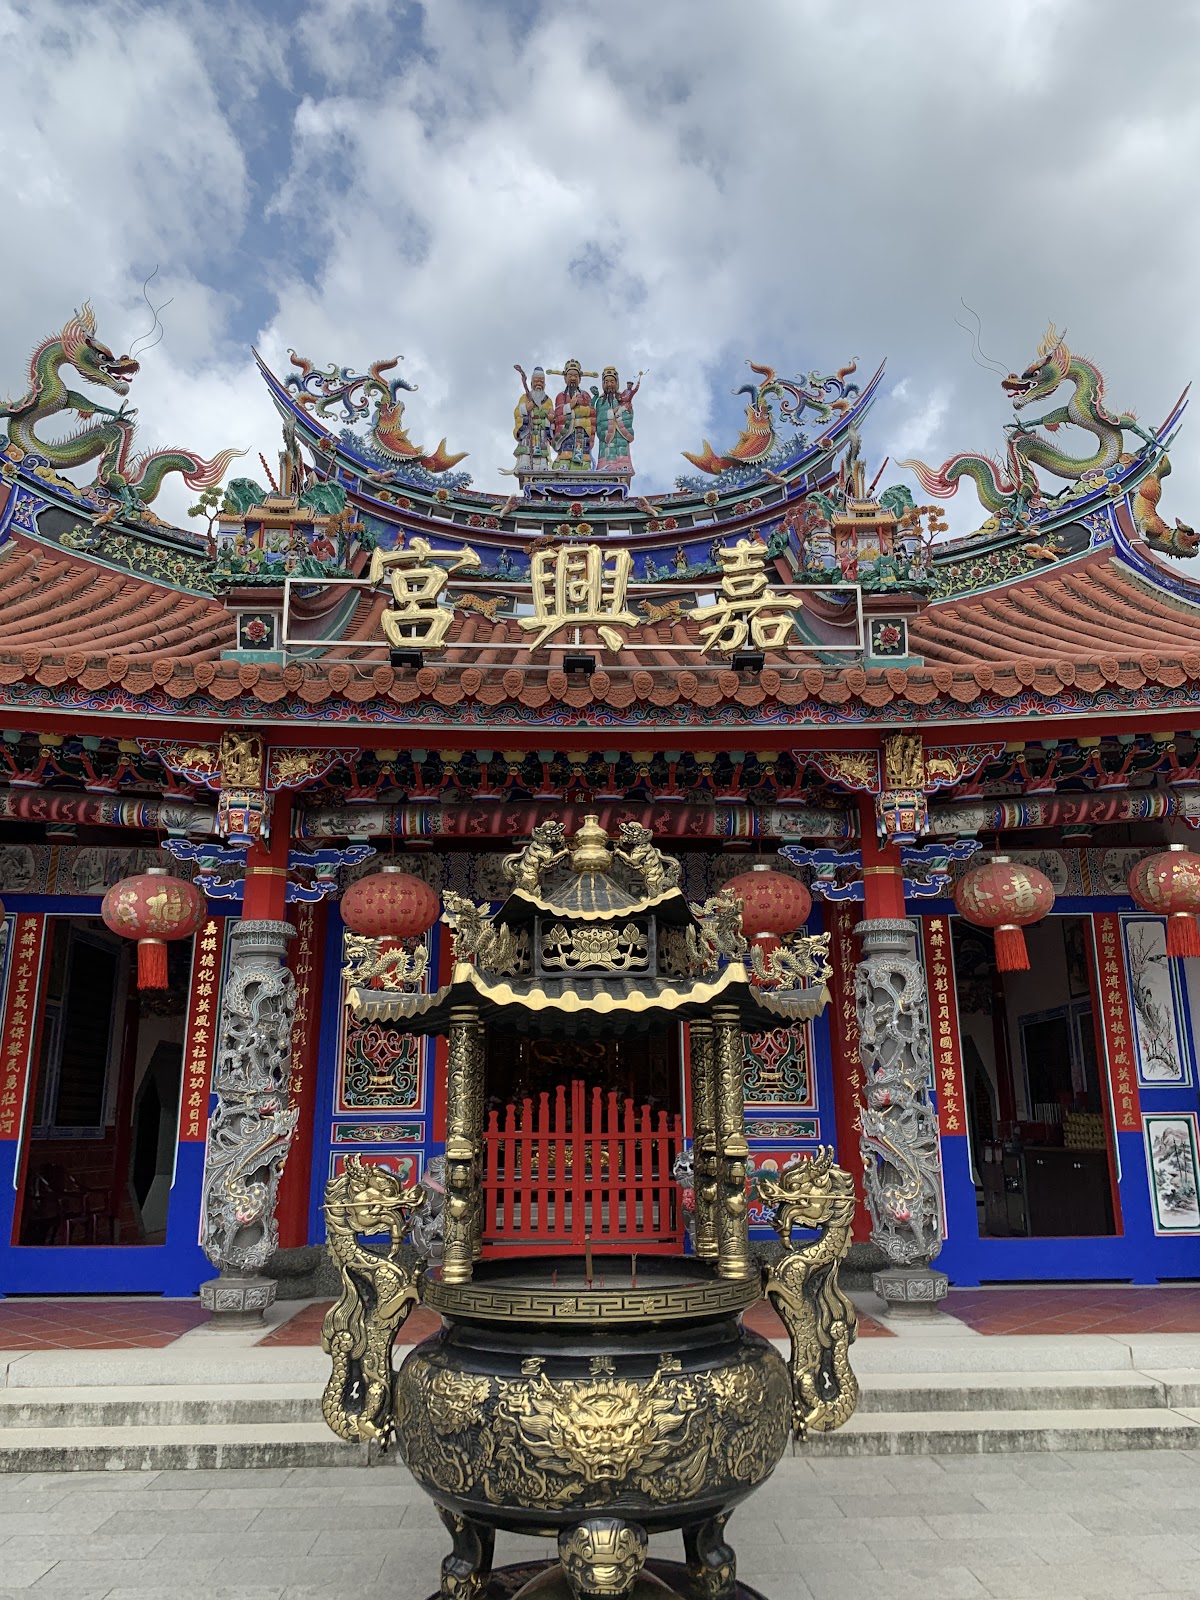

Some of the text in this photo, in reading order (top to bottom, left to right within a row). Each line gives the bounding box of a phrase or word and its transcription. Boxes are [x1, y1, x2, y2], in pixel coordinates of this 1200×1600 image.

[369, 537, 803, 655] 嘉興宮
[146, 885, 192, 922] 福
